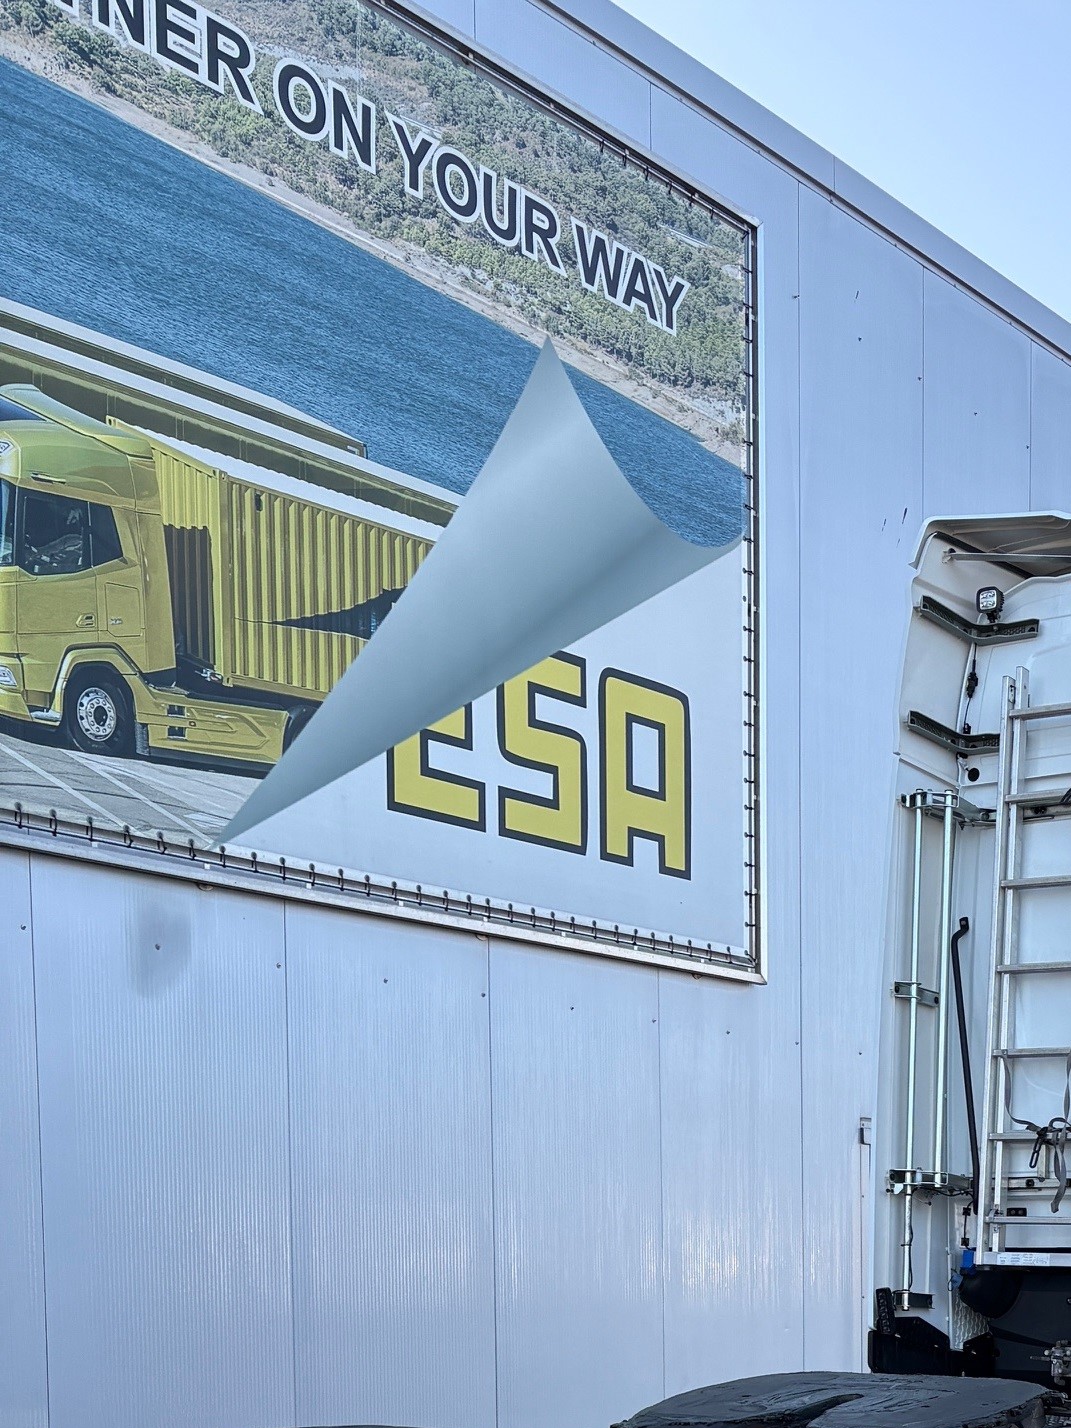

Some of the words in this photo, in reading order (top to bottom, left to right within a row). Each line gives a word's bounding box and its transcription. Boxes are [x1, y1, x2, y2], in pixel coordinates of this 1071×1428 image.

[53, 0, 263, 114] NER
[275, 60, 374, 171] ON
[388, 115, 565, 273] YOUR
[573, 219, 690, 334] WAY
